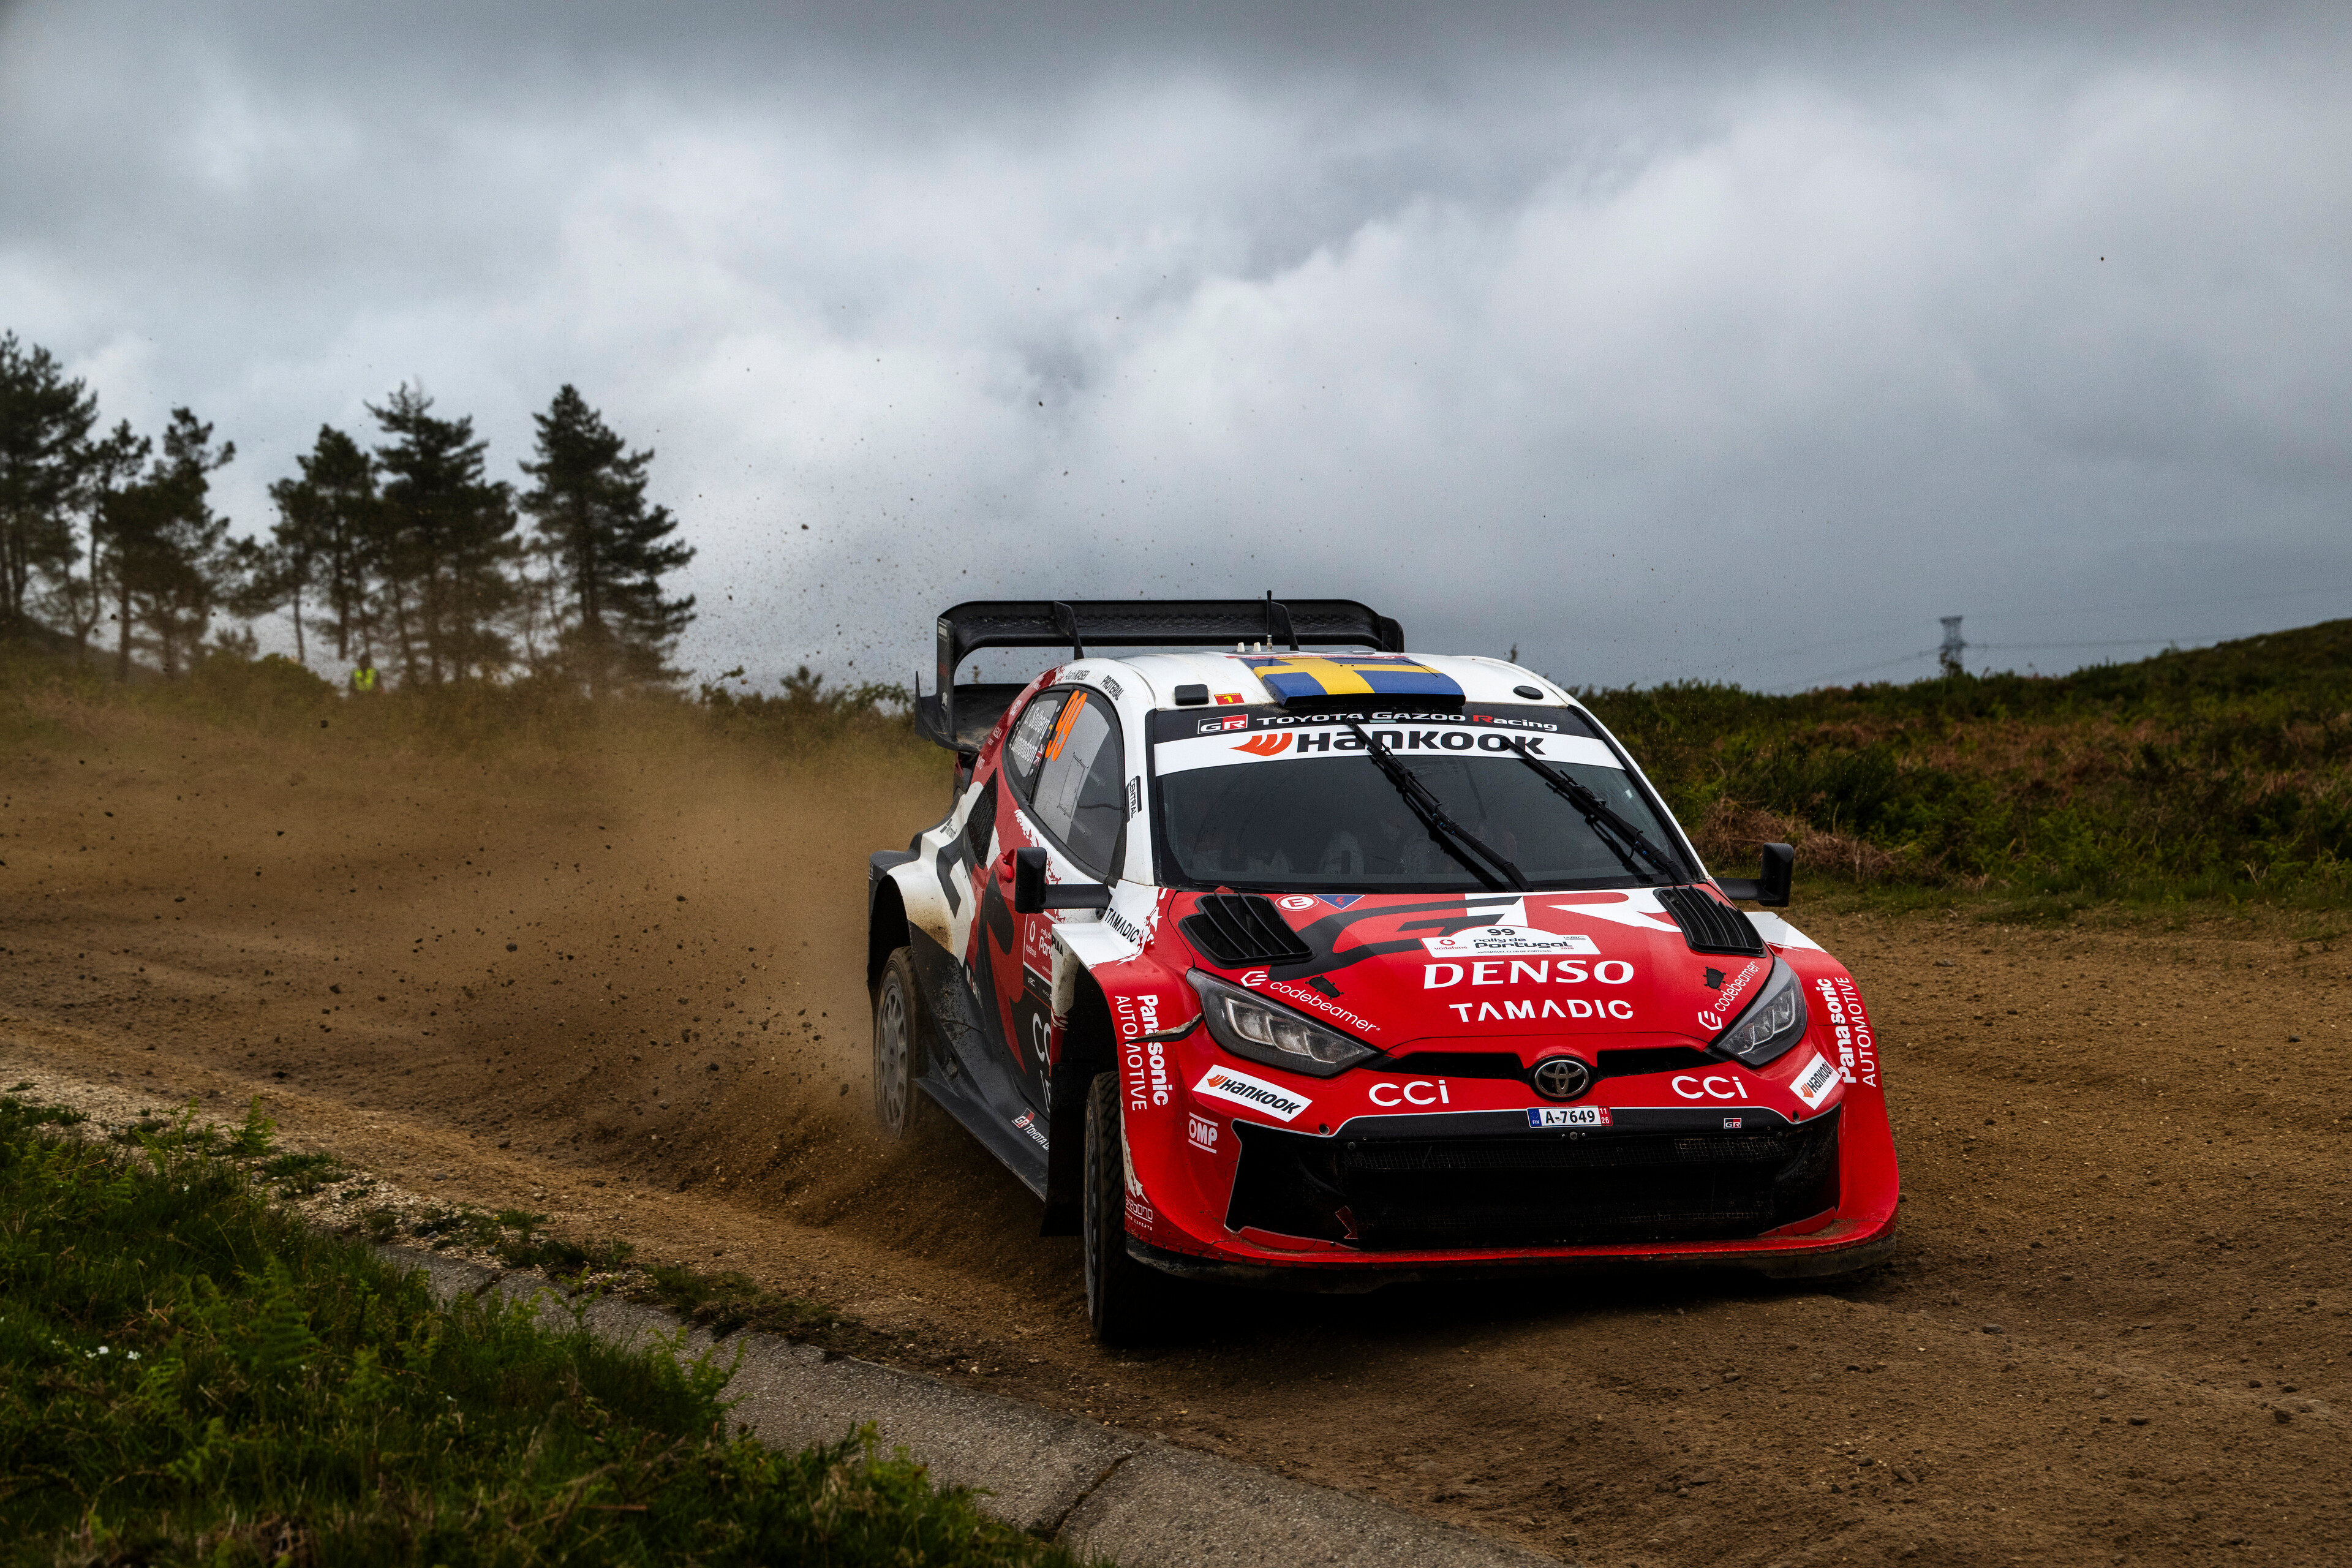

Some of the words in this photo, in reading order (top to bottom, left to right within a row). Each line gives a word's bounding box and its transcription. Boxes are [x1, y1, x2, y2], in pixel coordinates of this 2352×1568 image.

[1100, 675, 1125, 701] PROTERIAL
[1028, 706, 1051, 741] Solberg
[1045, 690, 1087, 761] 99
[1200, 720, 1246, 732] GR
[1256, 713, 1364, 726] TOYOTA
[1371, 712, 1466, 722] GAZOO
[1472, 715, 1558, 731] Racing
[1129, 777, 1138, 819] CENTRAL
[1287, 898, 1307, 908] E
[1104, 907, 1140, 943] TAMADIC
[1052, 934, 1064, 957] PIAA
[1423, 960, 1634, 989] DENSO
[1714, 962, 1760, 1012] codebeamer
[1270, 981, 1377, 1033] codebeamer
[1449, 1000, 1634, 1023] TAMADIC
[1815, 978, 1856, 1084] Panasonic
[1834, 977, 1877, 1088] AUTOMOTIVE
[1114, 995, 1147, 1111] AUTOMOTIVE
[1014, 1115, 1027, 1128] GR
[1024, 1123, 1047, 1145] TOYOTA
[1545, 1110, 1596, 1124] A-7649
[1188, 1119, 1218, 1147] OMP
[1134, 1219, 1153, 1231] EXPERTS
